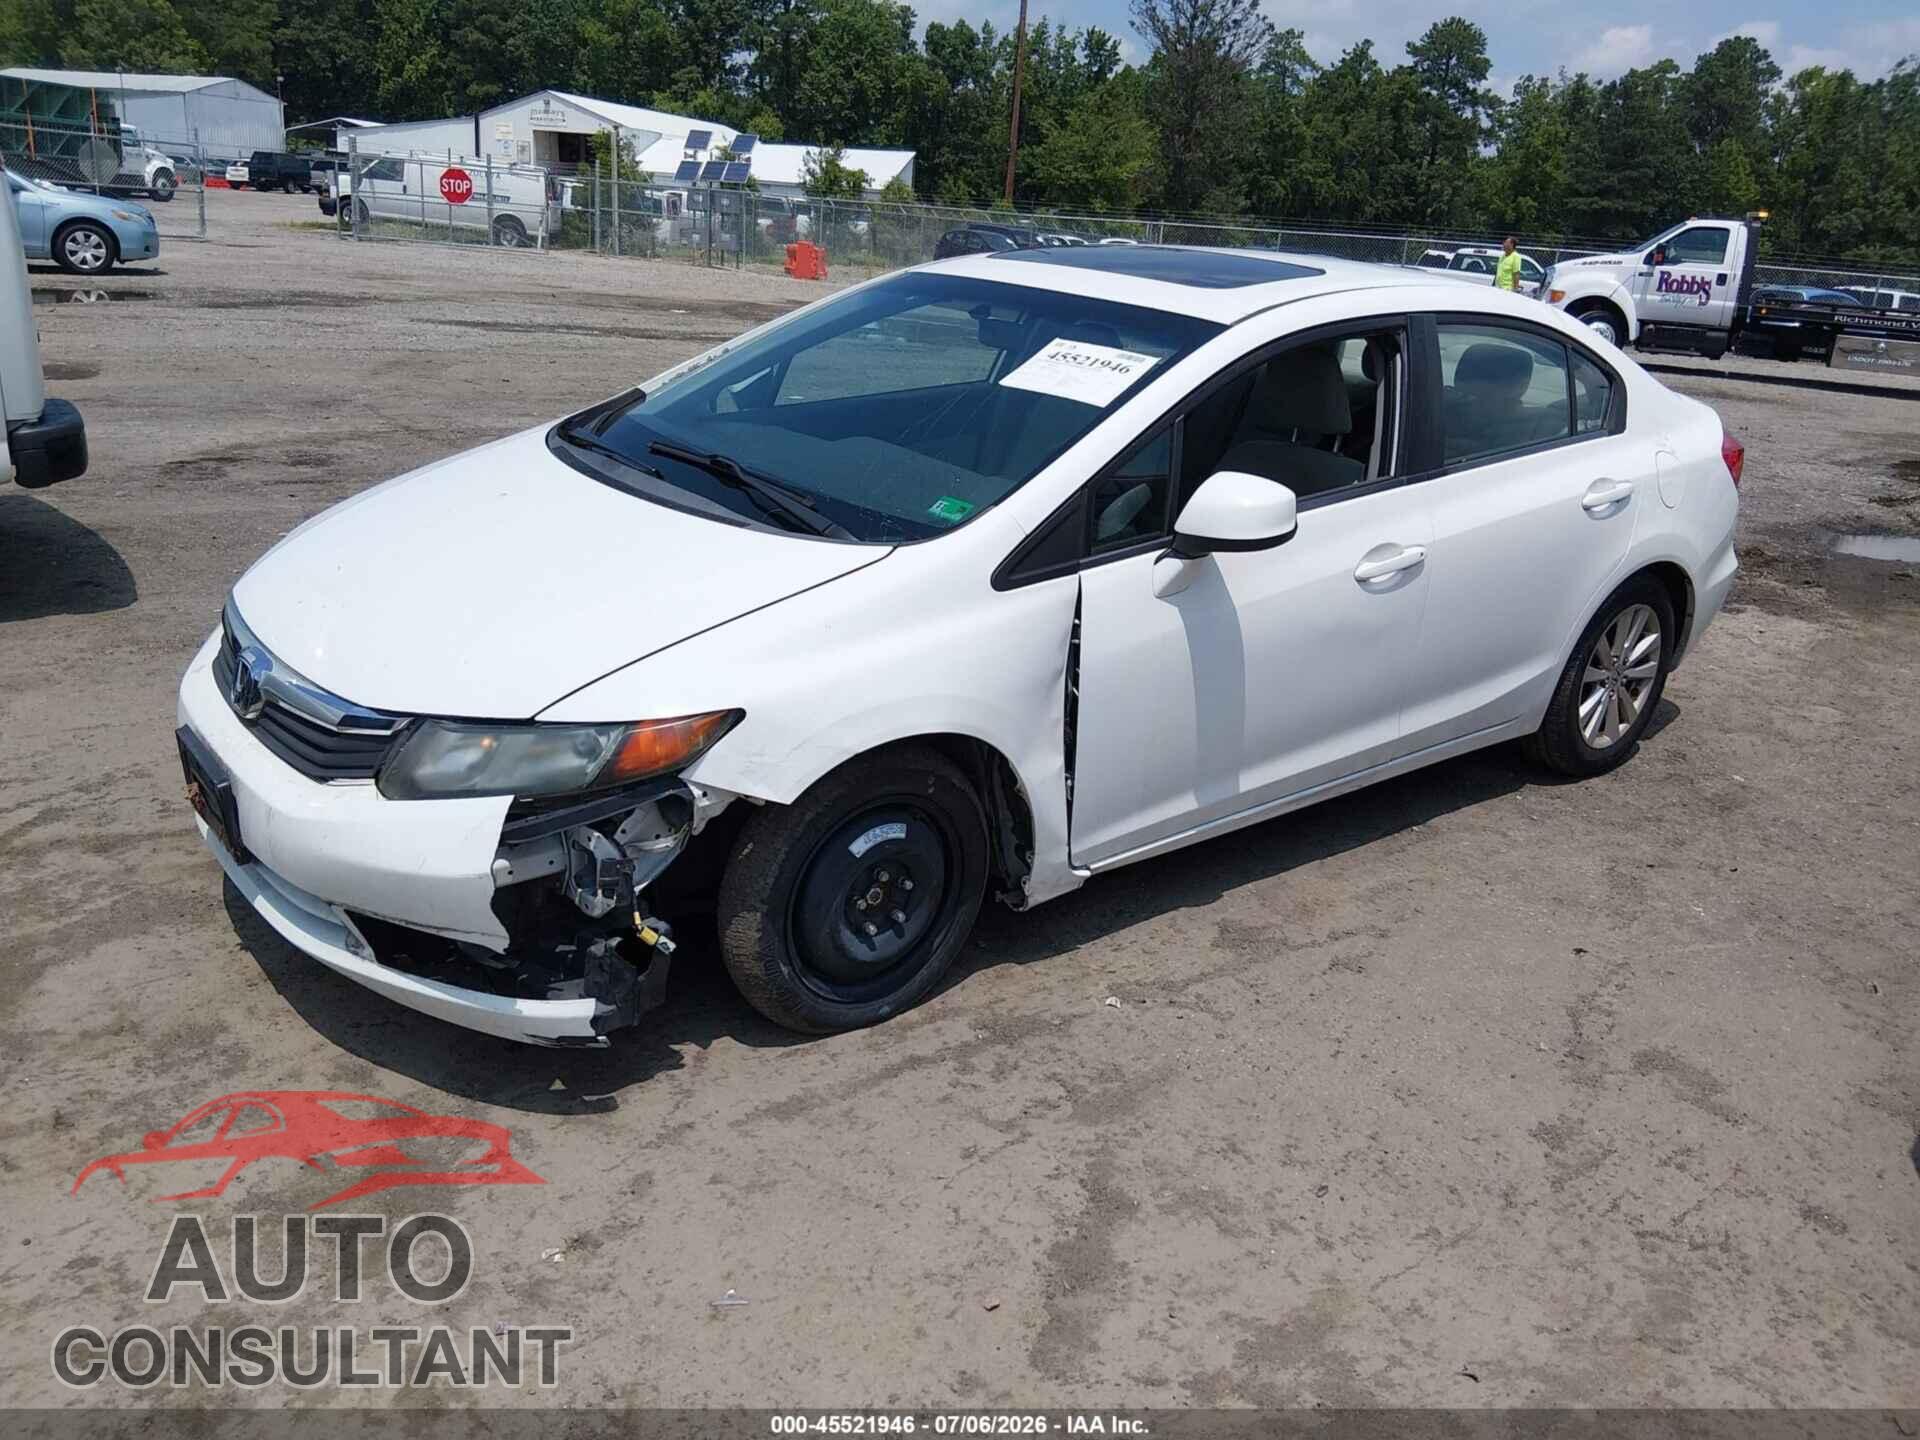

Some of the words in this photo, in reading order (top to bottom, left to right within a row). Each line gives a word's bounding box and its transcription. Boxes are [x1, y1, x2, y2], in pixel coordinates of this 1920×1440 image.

[441, 179, 471, 194] STOP
[1656, 270, 1712, 306] Robb's
[1047, 351, 1131, 375] 45521946
